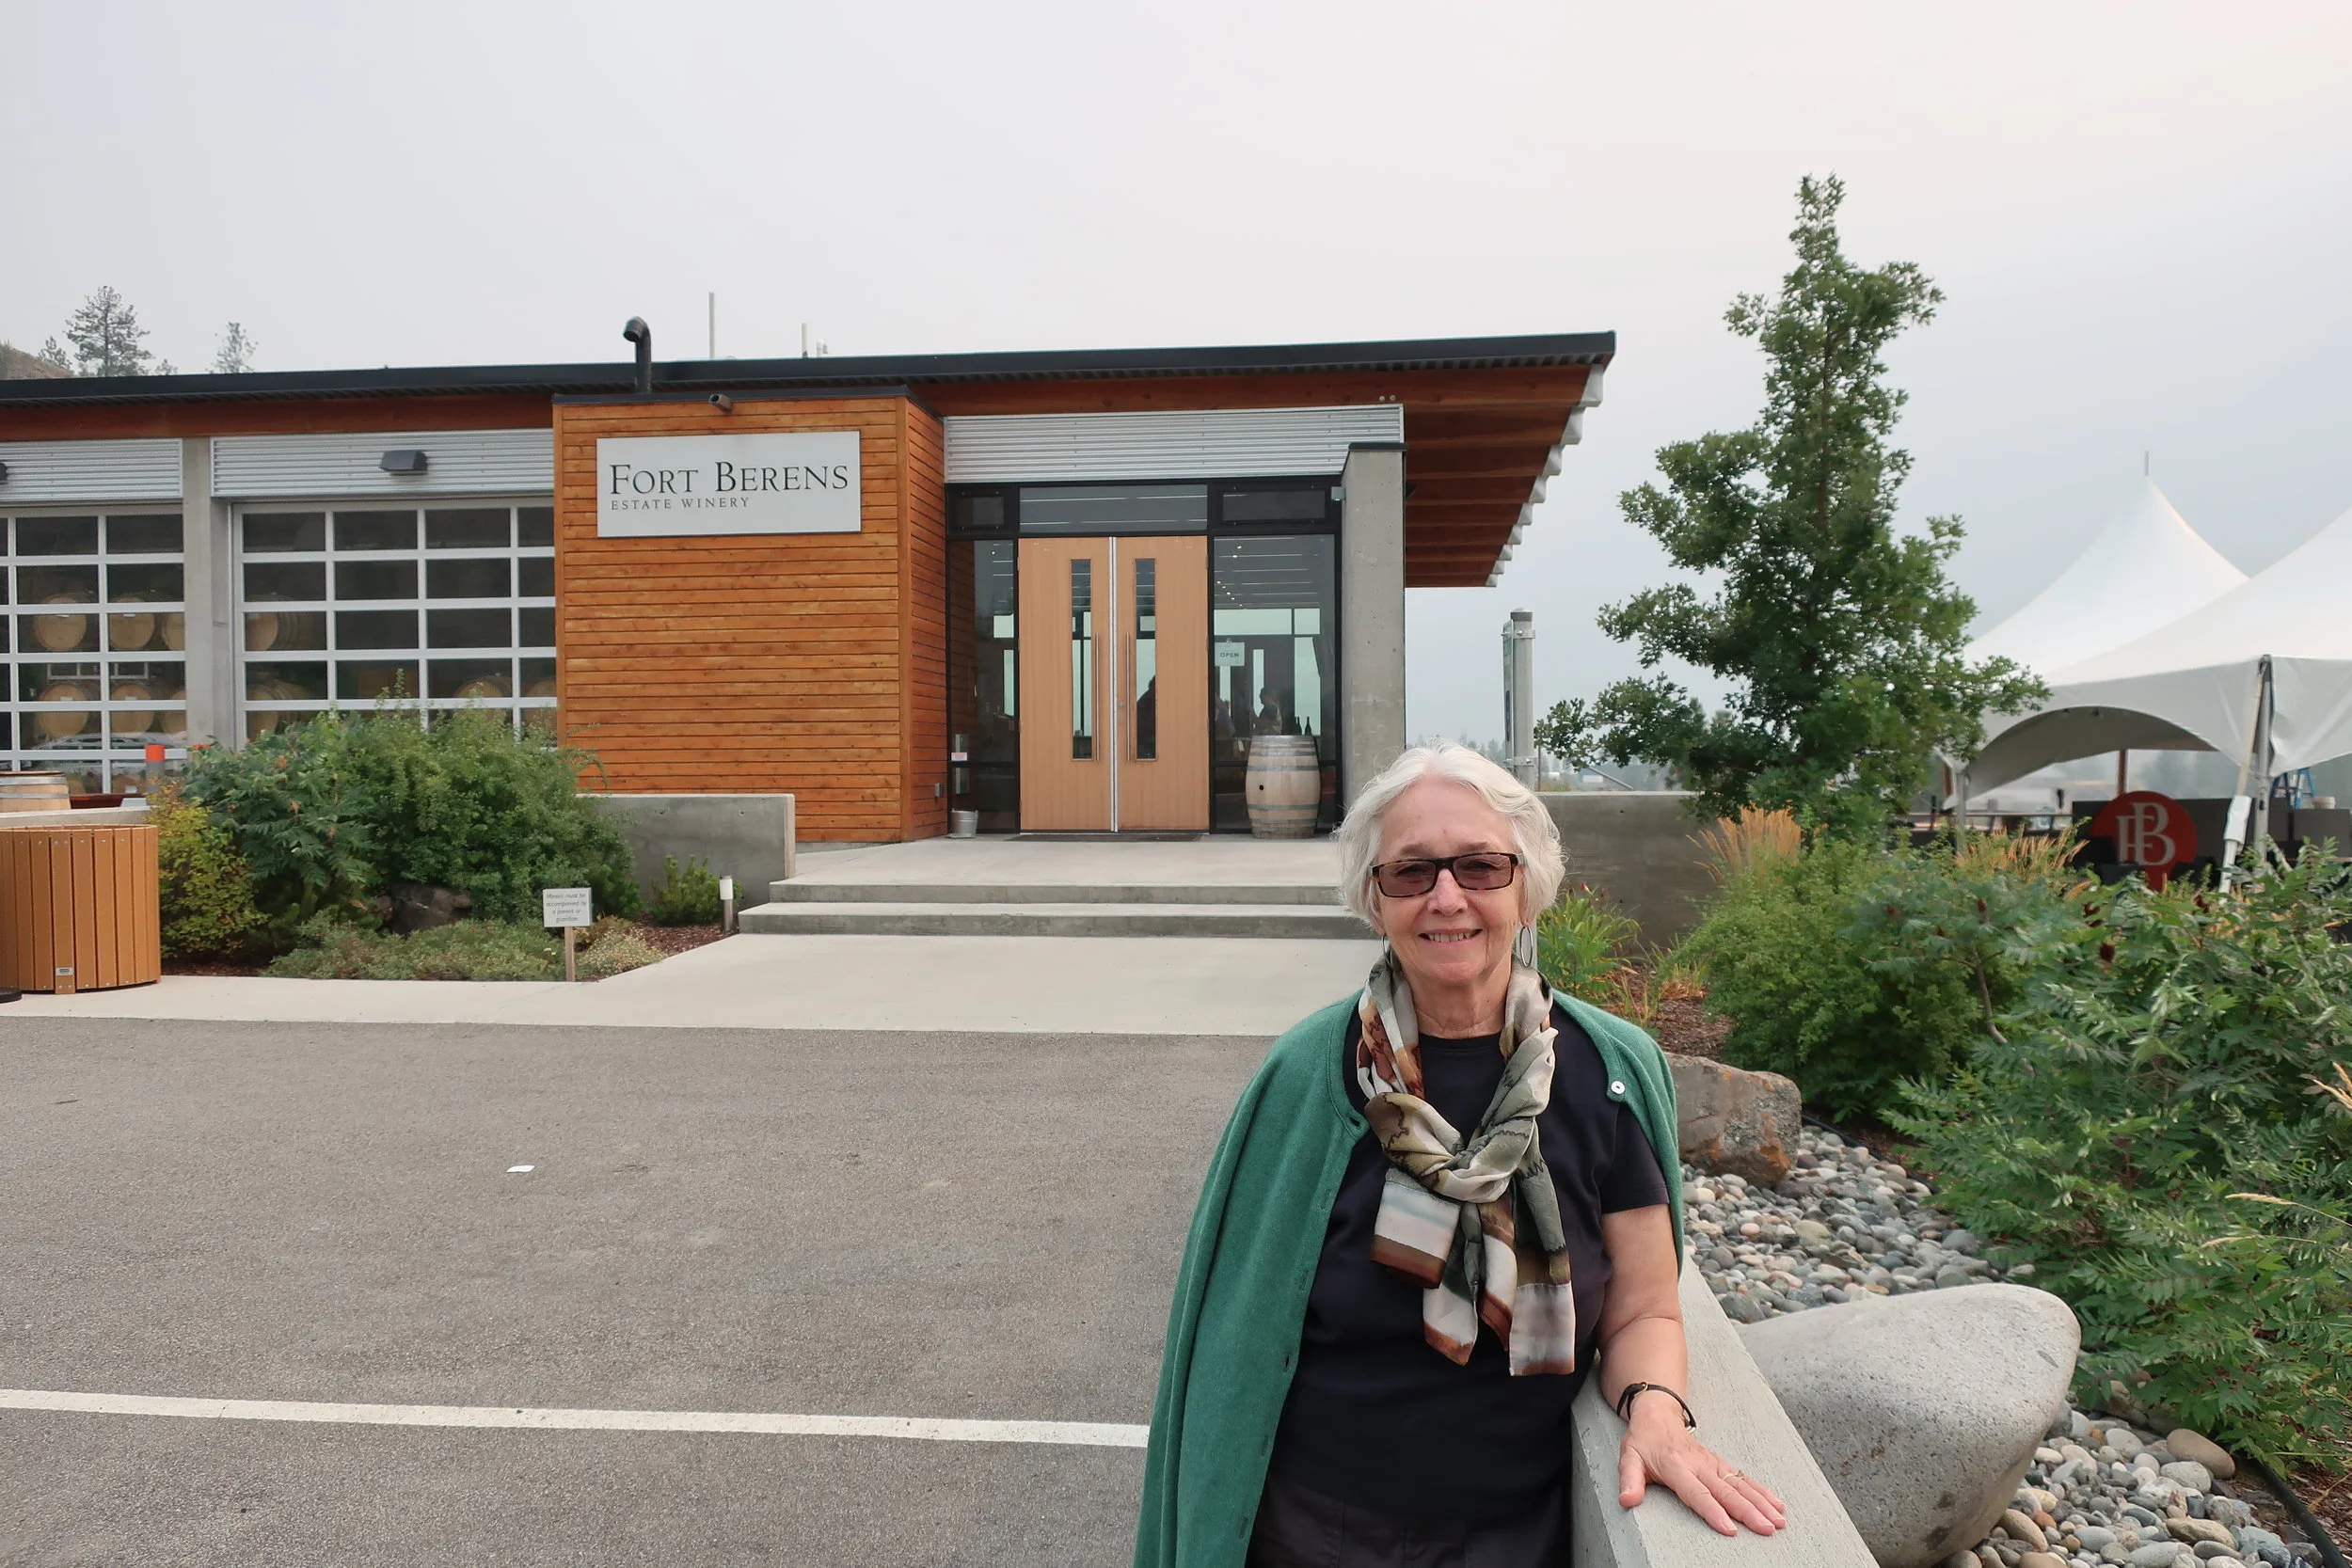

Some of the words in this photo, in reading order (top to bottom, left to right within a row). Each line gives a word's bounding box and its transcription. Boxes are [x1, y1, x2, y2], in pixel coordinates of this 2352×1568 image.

[610, 464, 699, 495] FORT
[715, 461, 849, 492] BERENS
[611, 499, 672, 511] ESTATE
[681, 497, 750, 509] WINERY
